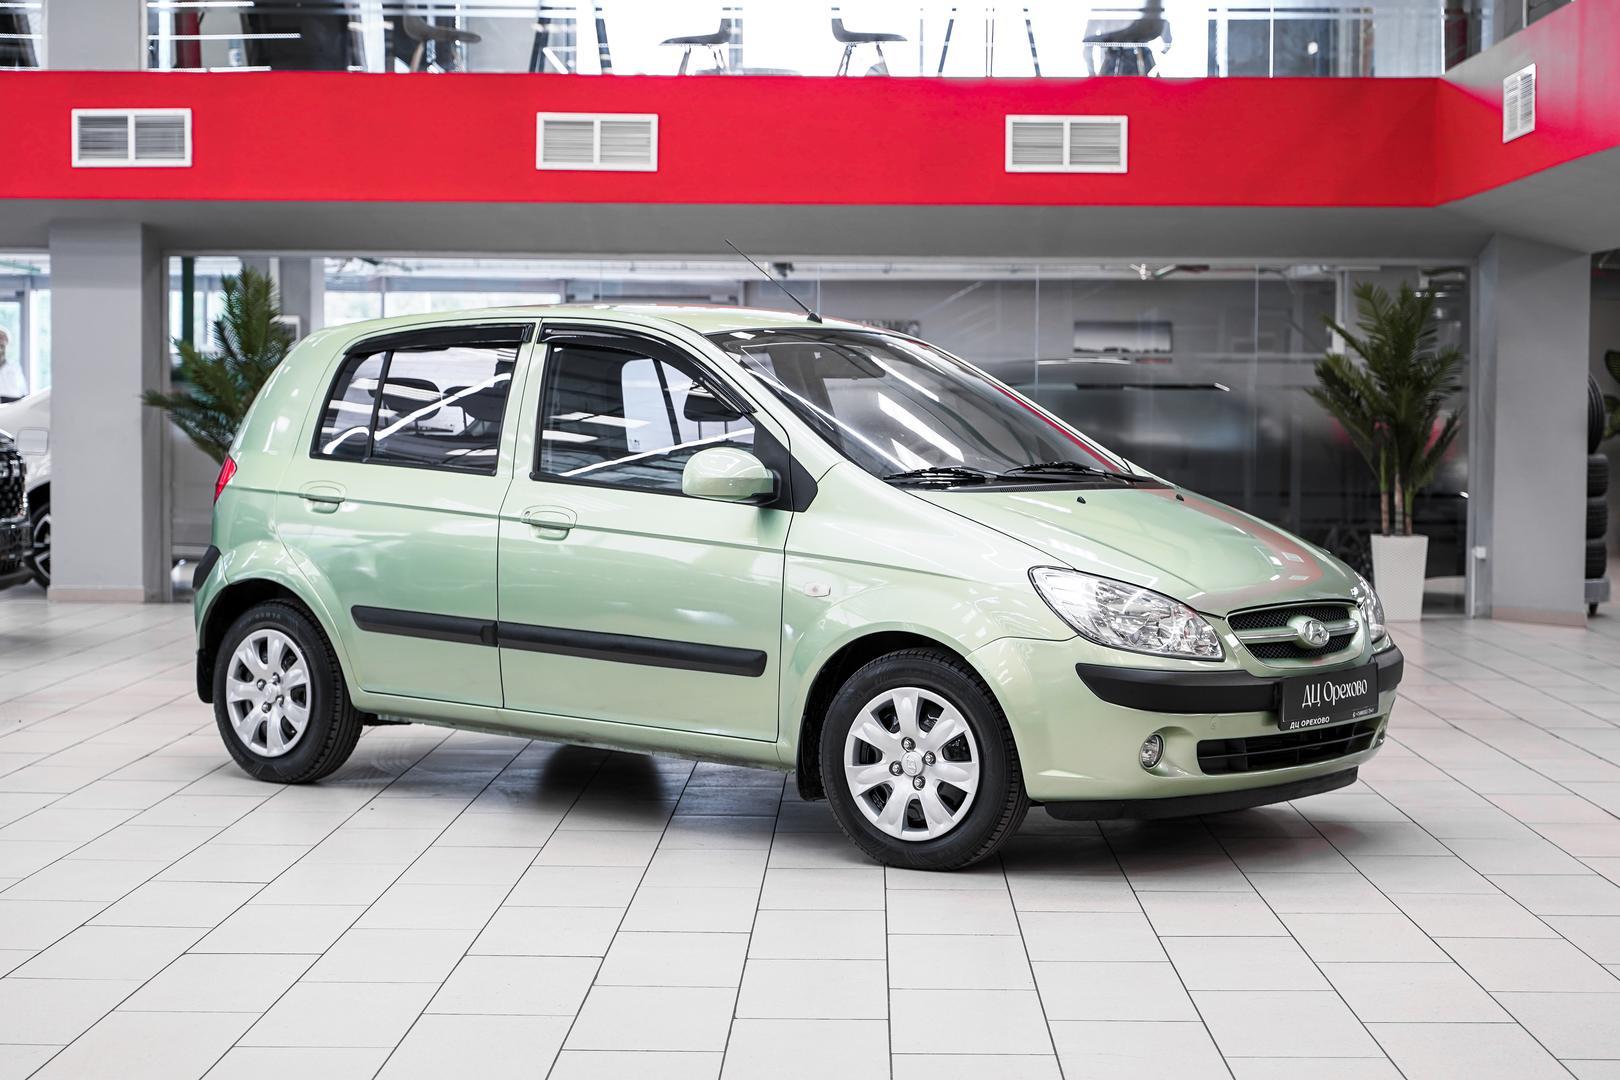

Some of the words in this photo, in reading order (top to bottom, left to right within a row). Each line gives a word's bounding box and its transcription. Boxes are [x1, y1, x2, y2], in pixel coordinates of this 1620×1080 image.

[1302, 683, 1321, 708] ДЦ
[1323, 679, 1368, 705] Орехово
[1290, 721, 1299, 730] ДЦ
[1300, 716, 1330, 727] ОРЕХОВО
